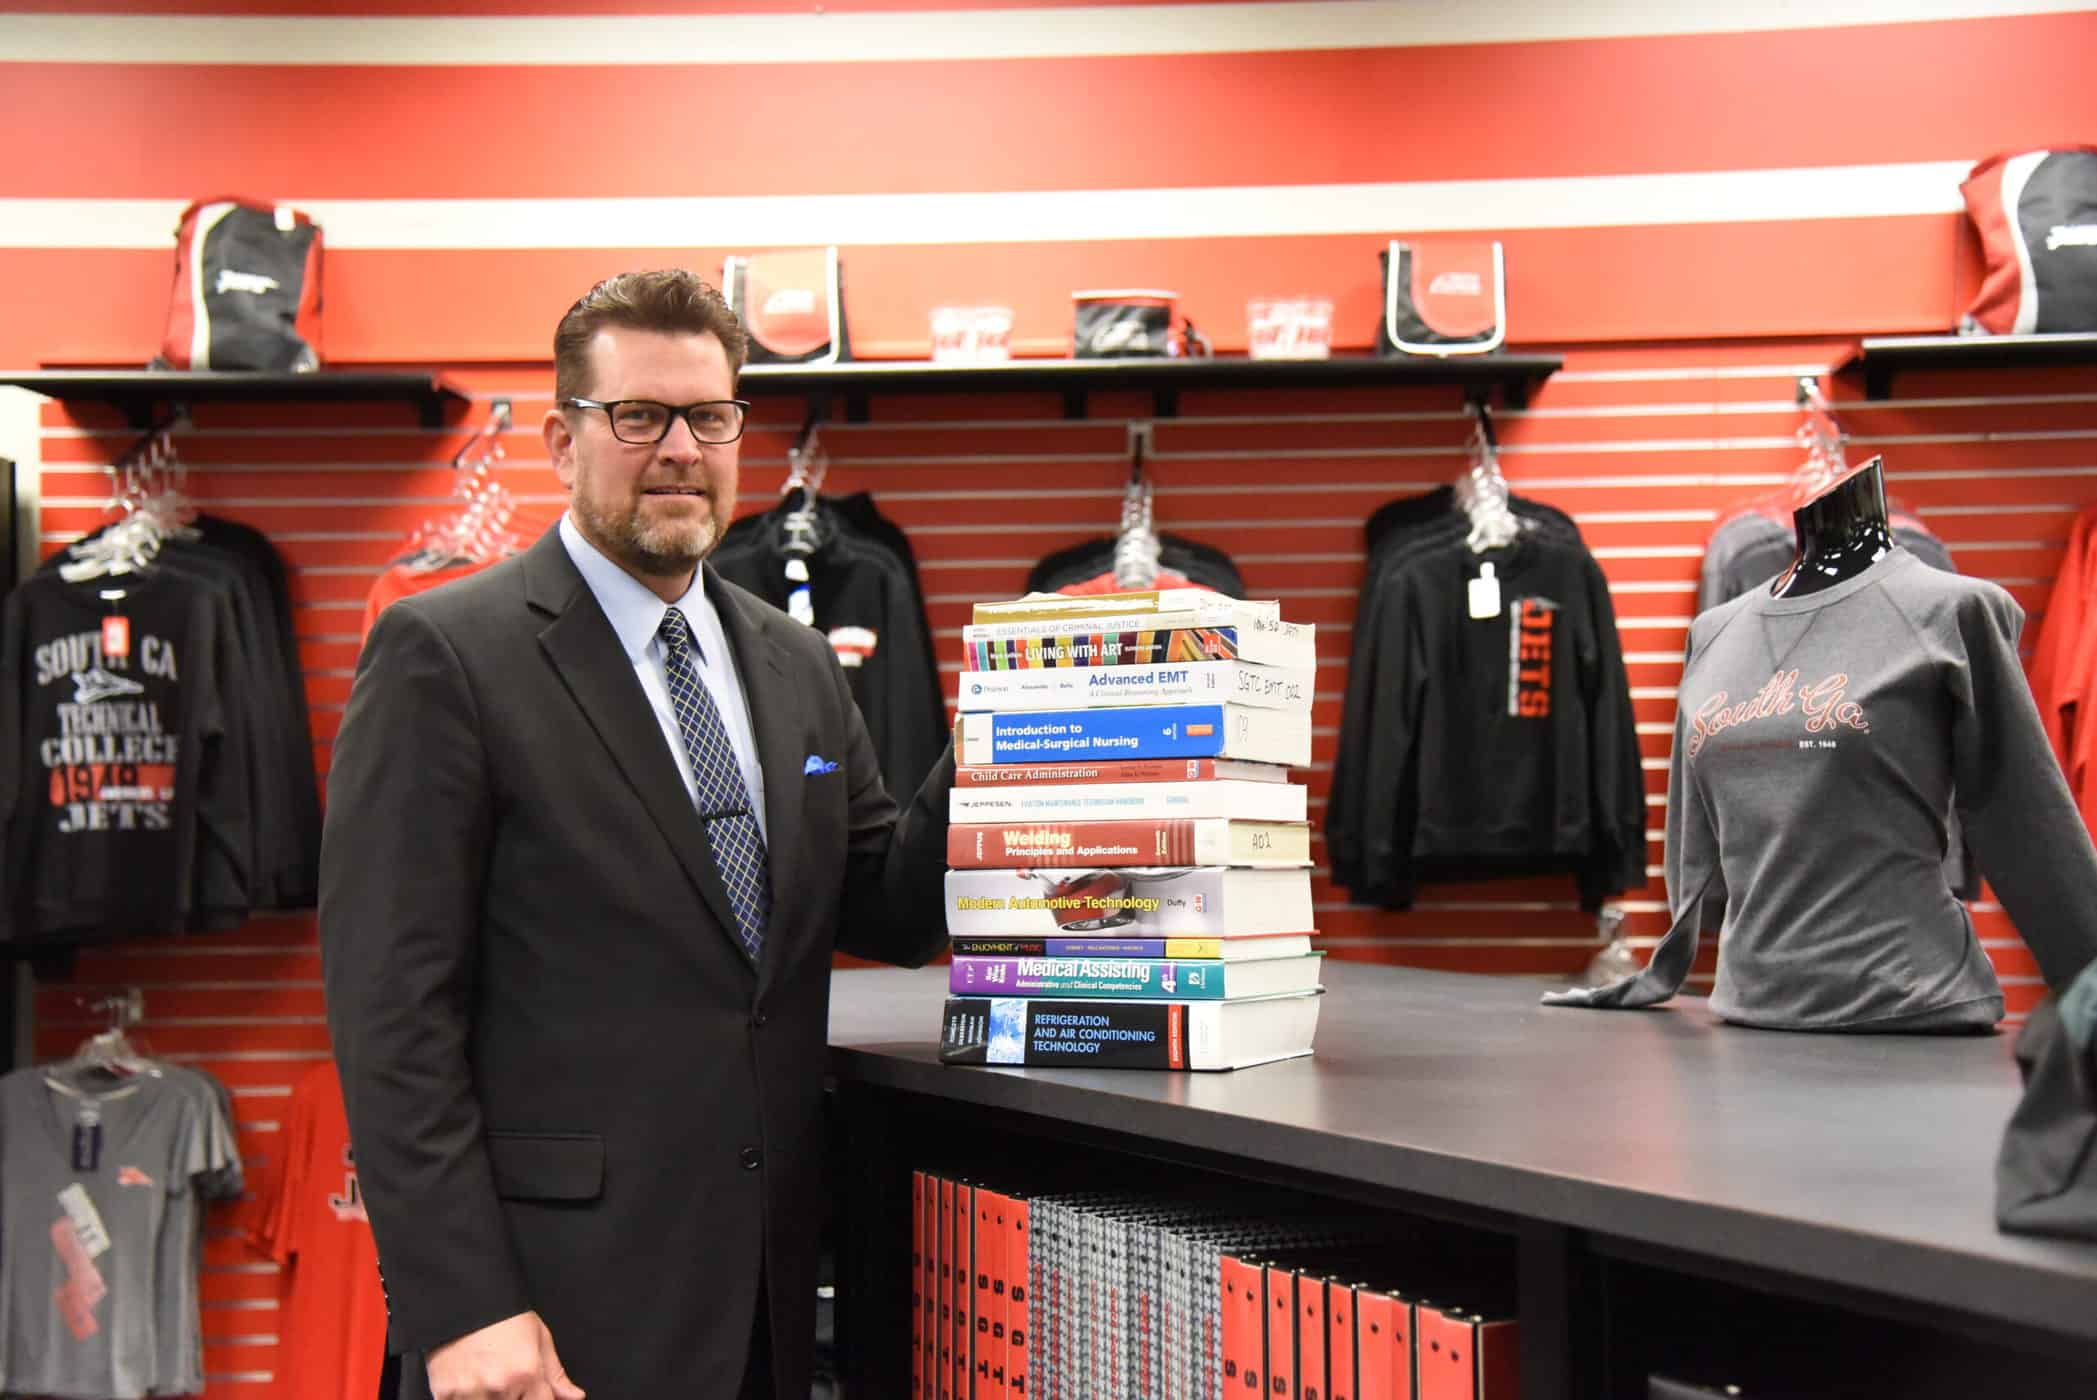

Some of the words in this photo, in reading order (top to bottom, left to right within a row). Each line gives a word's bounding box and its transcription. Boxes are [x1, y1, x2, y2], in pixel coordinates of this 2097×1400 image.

[1025, 646, 1065, 661] LIVING
[1067, 644, 1098, 659] WITH
[1101, 643, 1123, 657] ART
[1519, 600, 1553, 717] JETS
[1089, 672, 1154, 687] Advanced
[1158, 671, 1189, 684] EMT
[1688, 669, 1799, 759] South
[996, 723, 1067, 737] Introduction
[1070, 724, 1082, 735] to
[996, 738, 1089, 753] Medical-Surgical
[1093, 735, 1139, 750] Nursing
[971, 771, 999, 782] Child
[1001, 770, 1024, 781] Care
[1026, 768, 1098, 780] Administration
[58, 800, 171, 832] JETS
[1003, 830, 1072, 847] Welding
[1005, 846, 1054, 858] Principles
[1056, 846, 1074, 856] and
[1076, 845, 1138, 858] Applications
[957, 896, 1005, 910] Modern
[1009, 895, 1081, 910] Automotive
[1083, 895, 1160, 912] Technology
[1167, 898, 1187, 908] Duffy
[1017, 959, 1077, 977] Medical
[1080, 959, 1151, 983] Assisting
[1034, 1013, 1110, 1027] REFRIGERATION
[1034, 1027, 1057, 1039] AND
[1060, 1028, 1076, 1040] AIR
[1079, 1029, 1156, 1043] CONDITIONING
[1033, 1040, 1101, 1054] TECHNOLOGY
